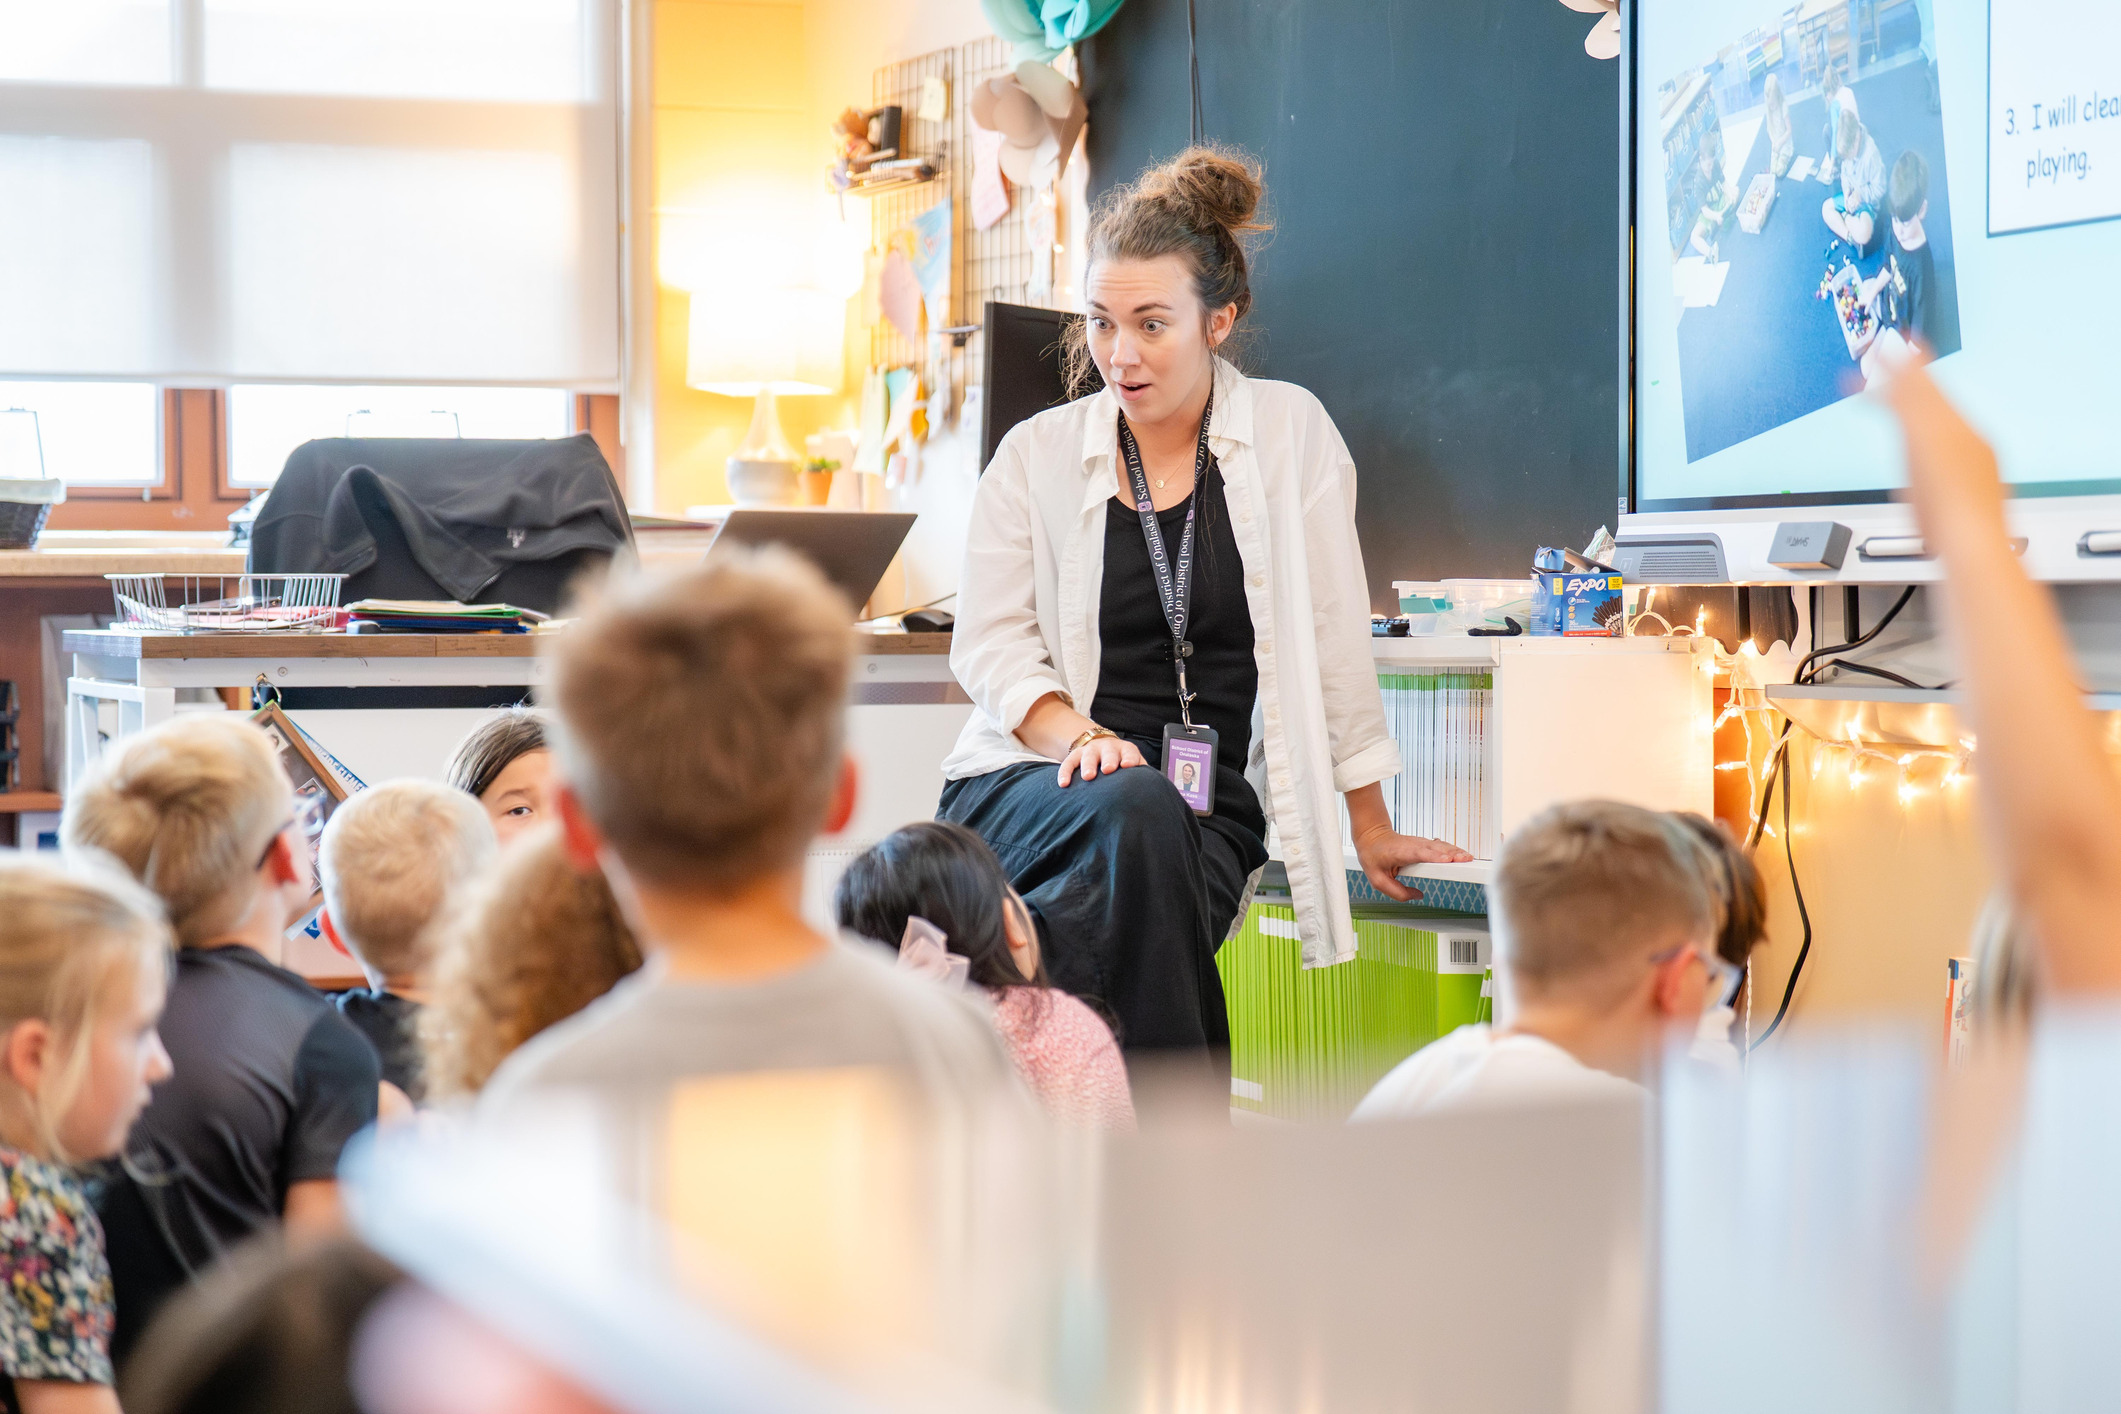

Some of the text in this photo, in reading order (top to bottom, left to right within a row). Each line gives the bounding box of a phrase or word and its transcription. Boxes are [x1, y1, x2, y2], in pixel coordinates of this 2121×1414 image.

[2005, 90, 2121, 135] 3. I will clea
[2027, 146, 2092, 189] playing.
[1123, 429, 1139, 465] District
[1131, 466, 1148, 501] School
[1145, 515, 1164, 560] Onalaska
[1155, 562, 1167, 573] of
[1173, 522, 1193, 639] School District of Onal
[1566, 578, 1607, 597] EXPO
